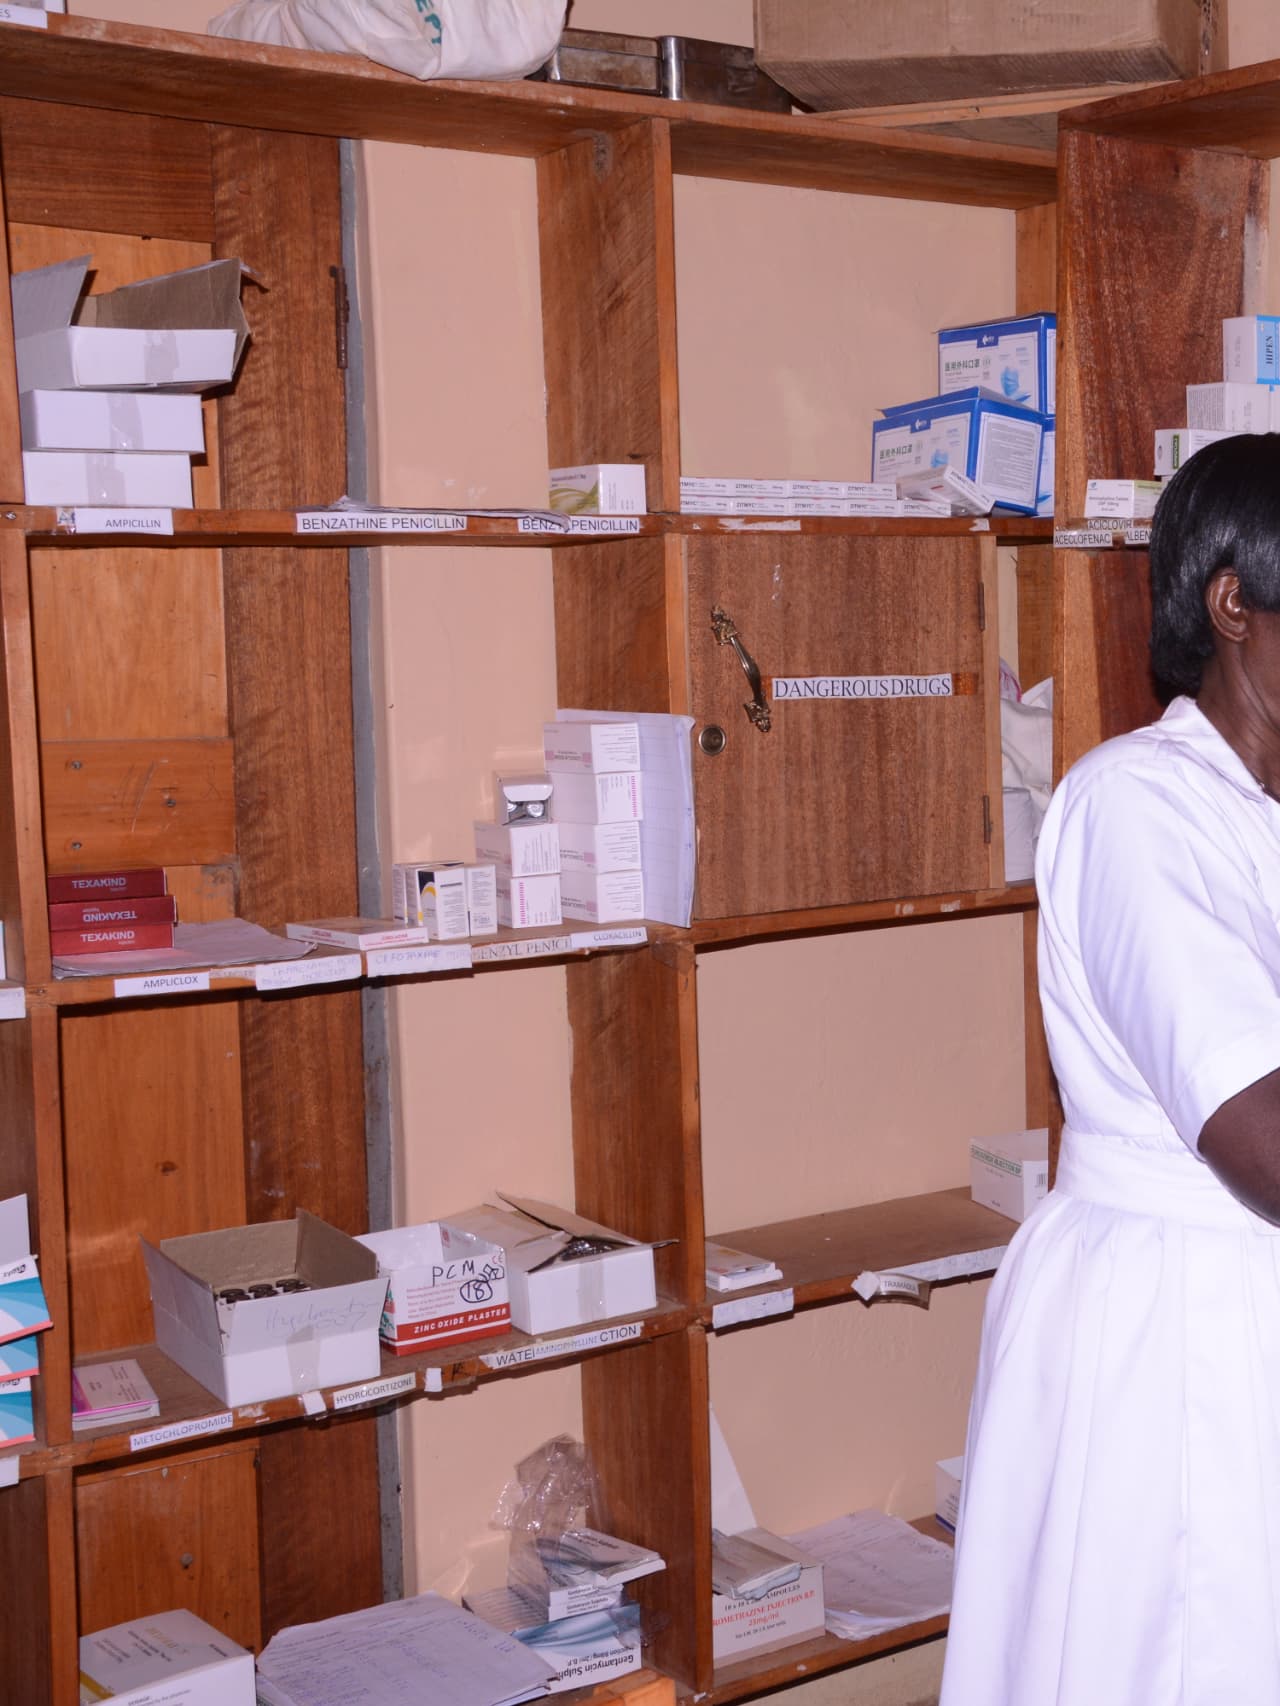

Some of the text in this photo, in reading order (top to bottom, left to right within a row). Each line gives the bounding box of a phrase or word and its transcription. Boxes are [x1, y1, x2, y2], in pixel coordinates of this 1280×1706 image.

[105, 519, 161, 528] AMPICILLIN
[302, 517, 465, 530] BENZATHINE PENICILLIN
[571, 520, 638, 531] PENICILLIN
[1054, 533, 1111, 545] ACECLOFENAC
[775, 678, 951, 698] DANGEROUS DRUGS
[72, 877, 126, 889] TEXAKIND
[83, 911, 137, 922] TEXAKIND
[80, 930, 135, 942] TEXAKIND
[143, 975, 198, 989] AMPLICLOX
[414, 1307, 507, 1334] ZINC OXIDE PLASTER
[336, 1377, 414, 1405] HYDROCORTIZONE
[133, 1413, 233, 1447] METOCHLOPROMIDE
[559, 1654, 634, 1678] Gentamycin Sulph
